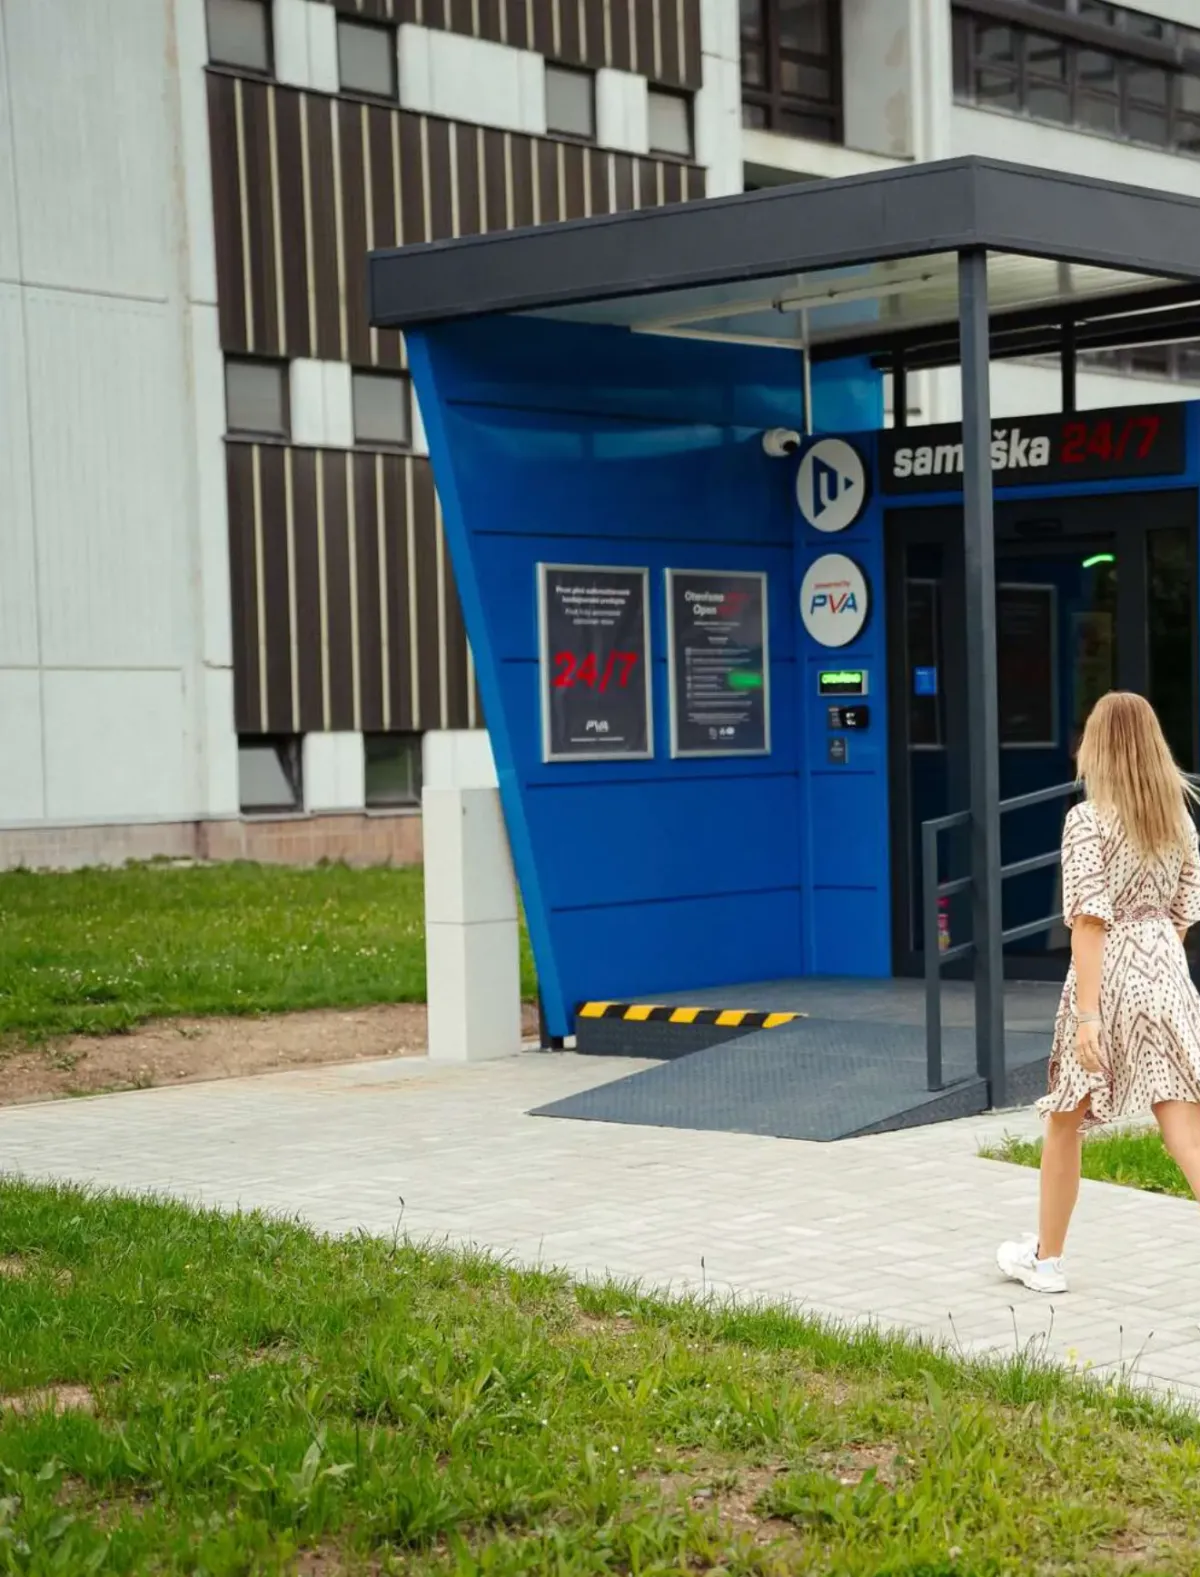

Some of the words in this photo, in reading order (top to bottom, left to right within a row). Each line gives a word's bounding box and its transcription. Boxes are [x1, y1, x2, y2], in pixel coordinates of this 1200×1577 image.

[893, 428, 1050, 478] samška
[1060, 415, 1161, 464] 24/7
[693, 603, 717, 617] Open
[810, 591, 858, 615] PVA
[550, 650, 639, 694] 24/7
